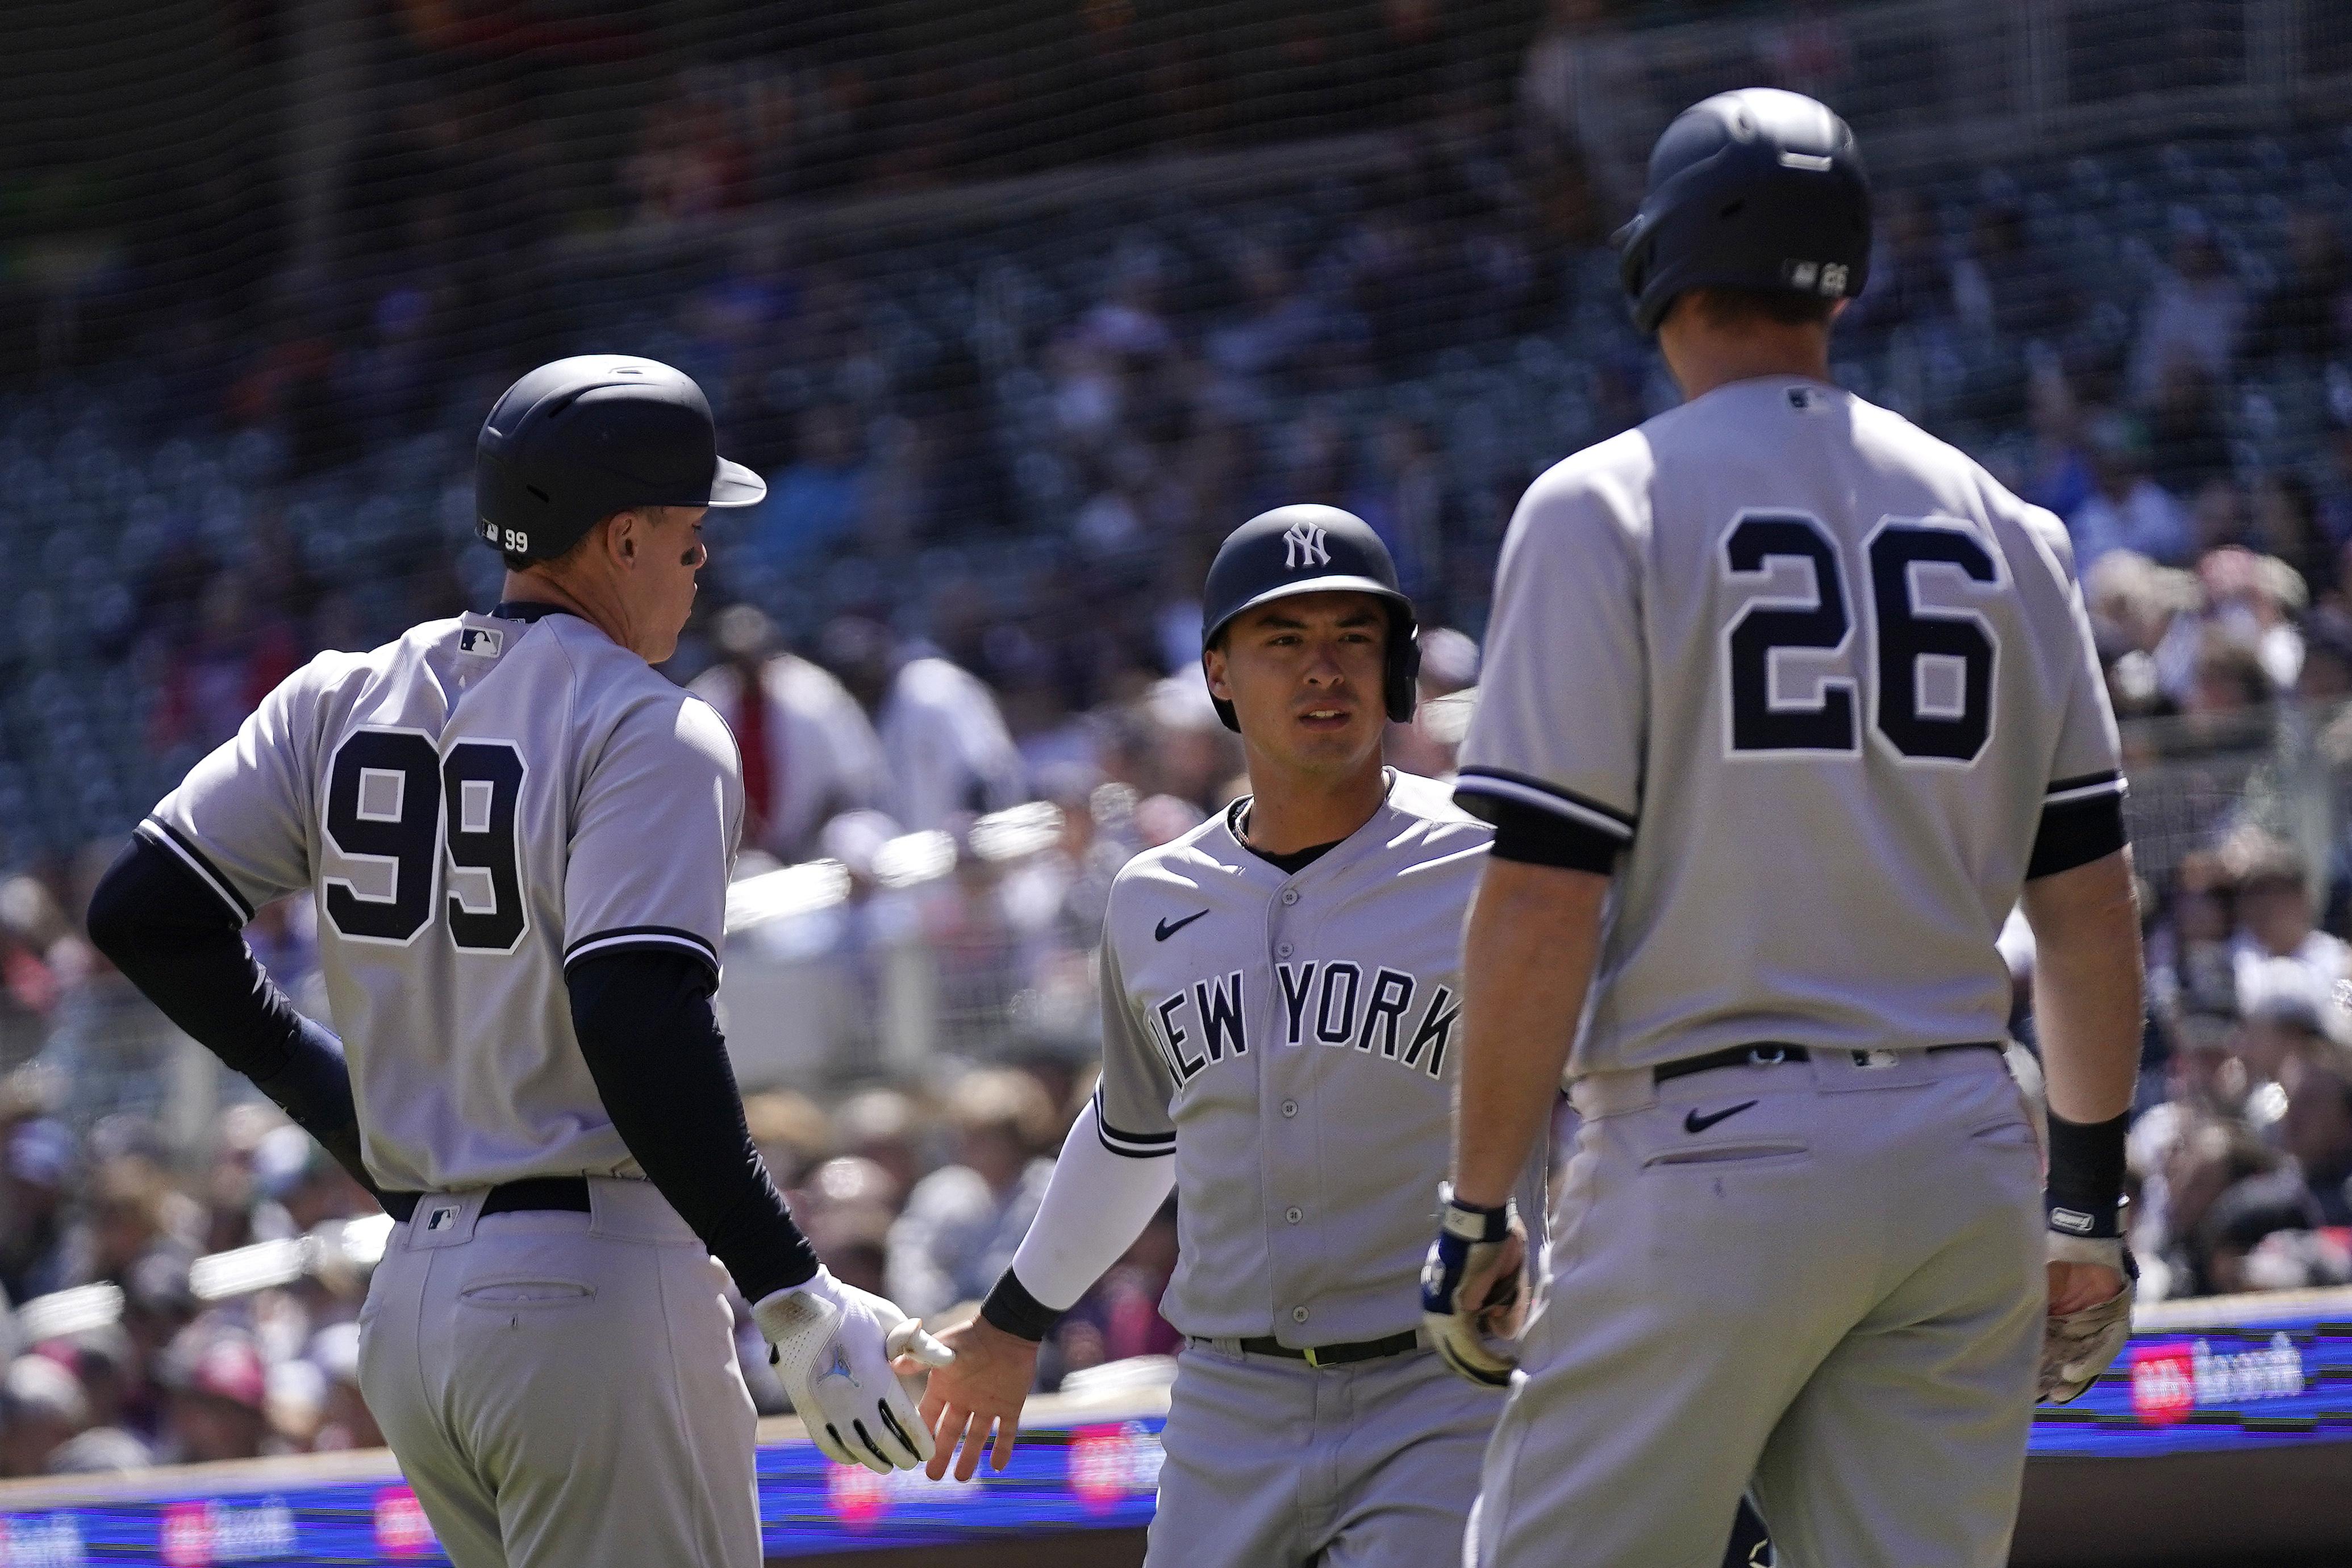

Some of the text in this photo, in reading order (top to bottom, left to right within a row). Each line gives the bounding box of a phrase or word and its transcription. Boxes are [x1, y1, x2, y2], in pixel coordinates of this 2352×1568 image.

[505, 529, 528, 553] 99
[1283, 522, 1332, 568] NY
[1720, 507, 2014, 770] 26
[322, 724, 530, 955] 99
[1274, 959, 1464, 1080] YORK
